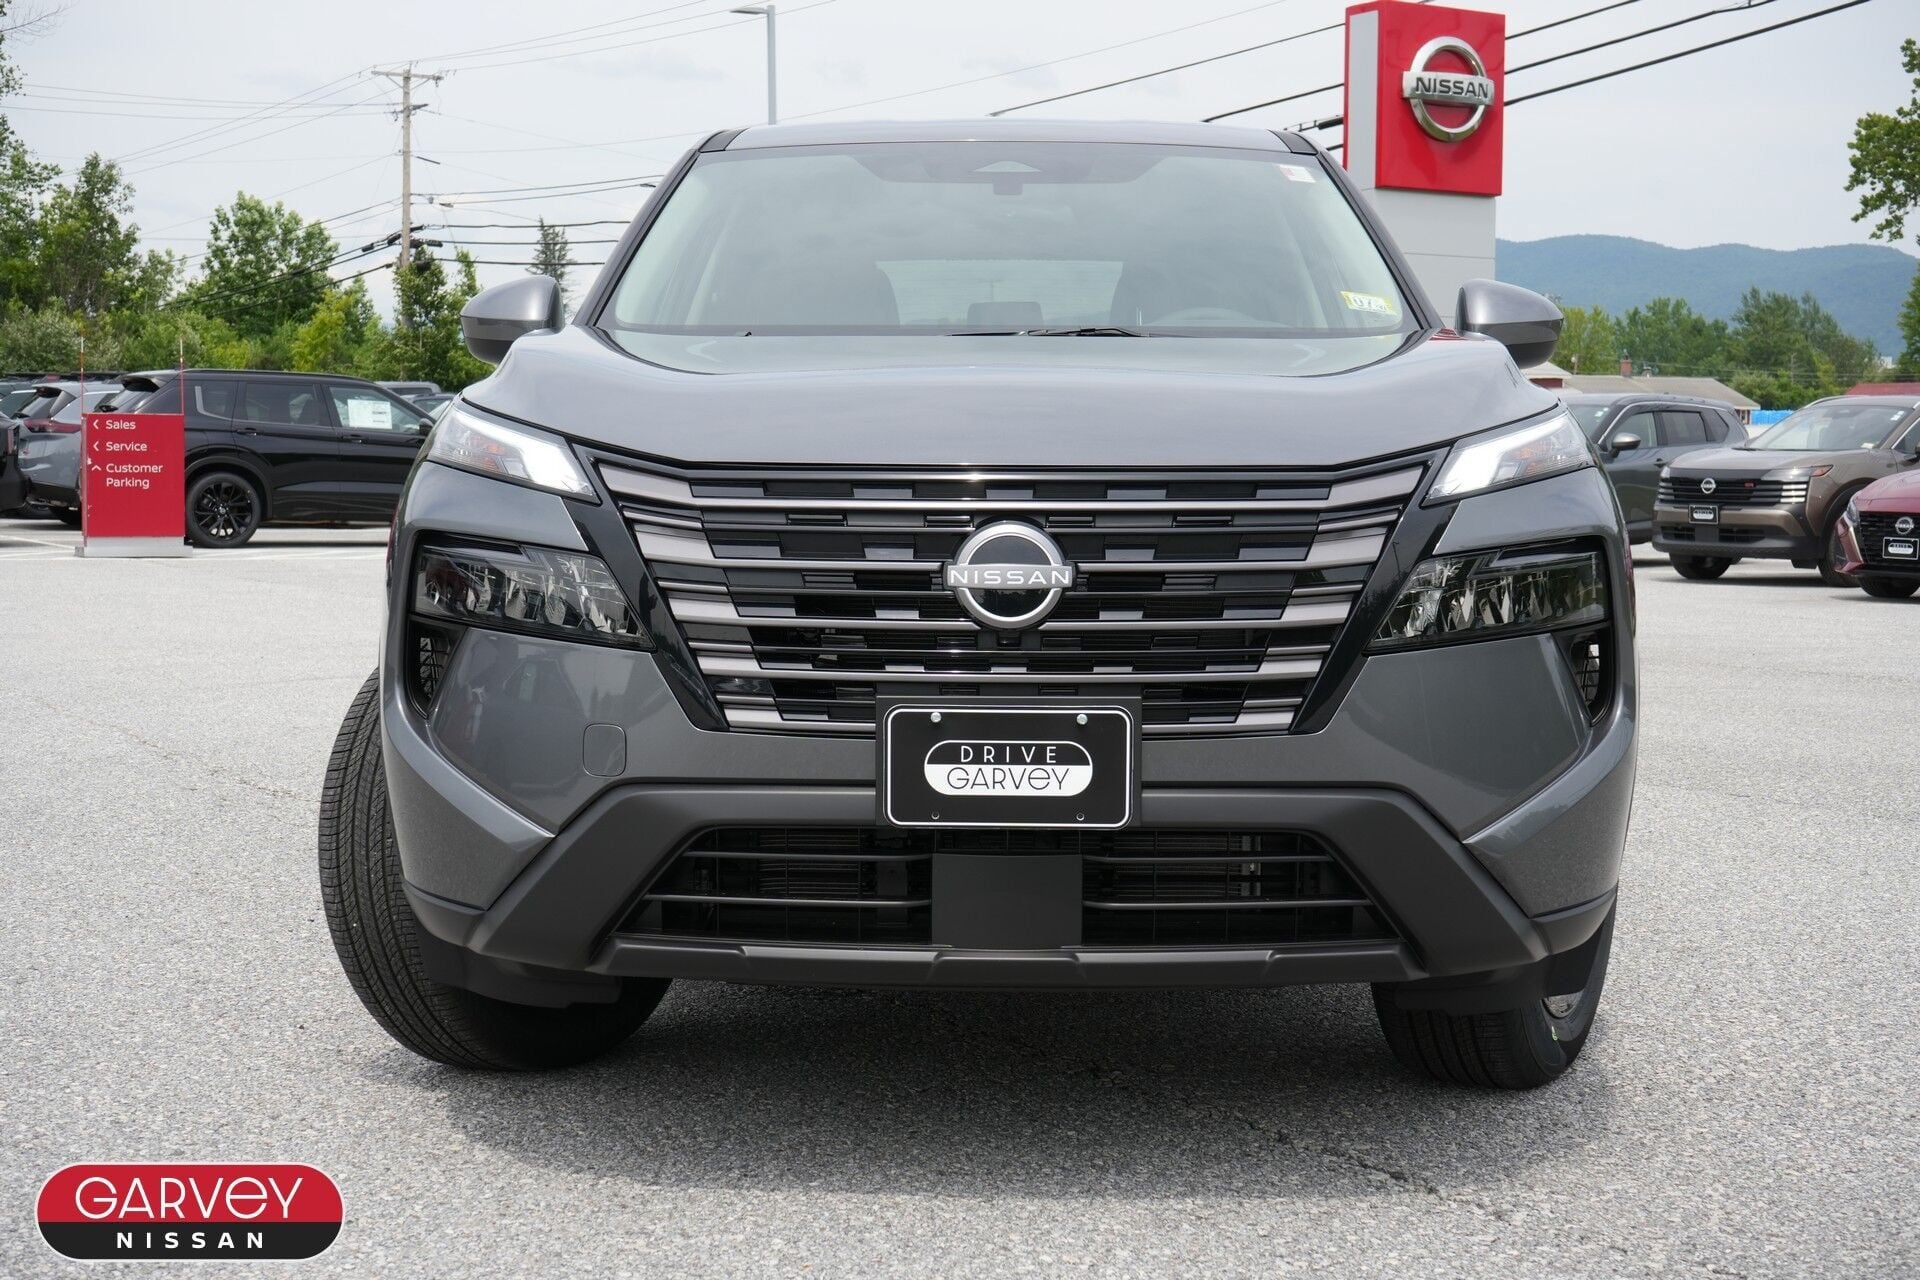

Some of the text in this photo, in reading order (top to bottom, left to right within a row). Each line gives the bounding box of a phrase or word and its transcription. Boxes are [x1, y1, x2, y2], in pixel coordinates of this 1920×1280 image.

[1415, 76, 1488, 99] NISSAN
[105, 419, 136, 430] Sales
[105, 441, 148, 452] Service
[105, 463, 163, 473] Customer
[106, 477, 150, 490] Parking
[949, 569, 1070, 585] NISSAN
[960, 745, 1057, 763] DRIVE
